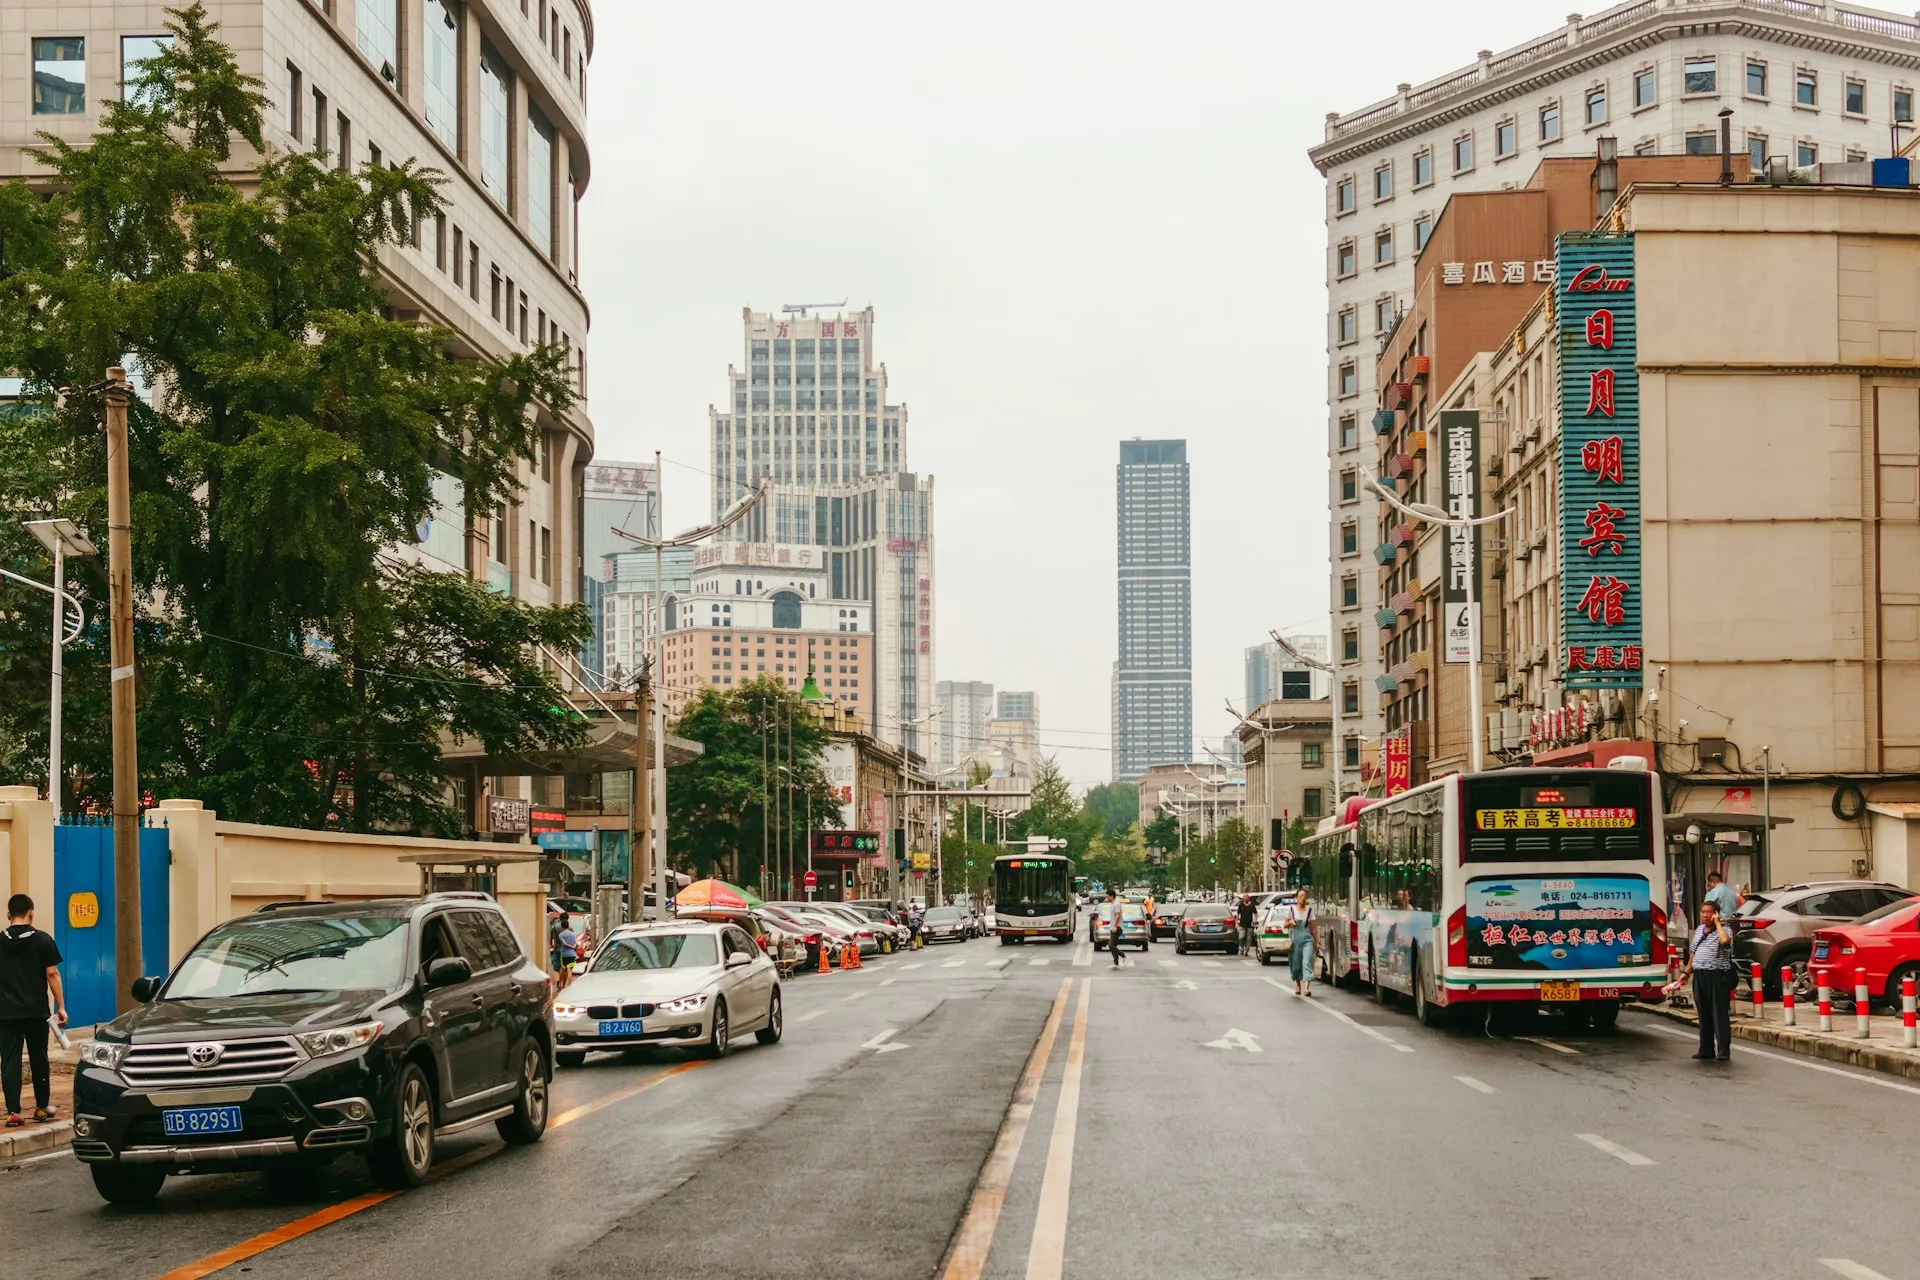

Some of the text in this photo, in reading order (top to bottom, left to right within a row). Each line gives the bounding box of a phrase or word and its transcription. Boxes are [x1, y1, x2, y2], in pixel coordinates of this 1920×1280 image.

[1442, 260, 1556, 285] 喜瓜酒店
[1578, 308, 1631, 626] 日月明宾馆
[1567, 645, 1643, 670] 民康店
[1481, 810, 1561, 828] 育荣高考
[1584, 809, 1615, 818] 高三全托
[1618, 809, 1633, 818] 艺考
[1575, 818, 1632, 827] 84666667
[1542, 989, 1578, 1000] K6587
[1598, 988, 1618, 997] LNG
